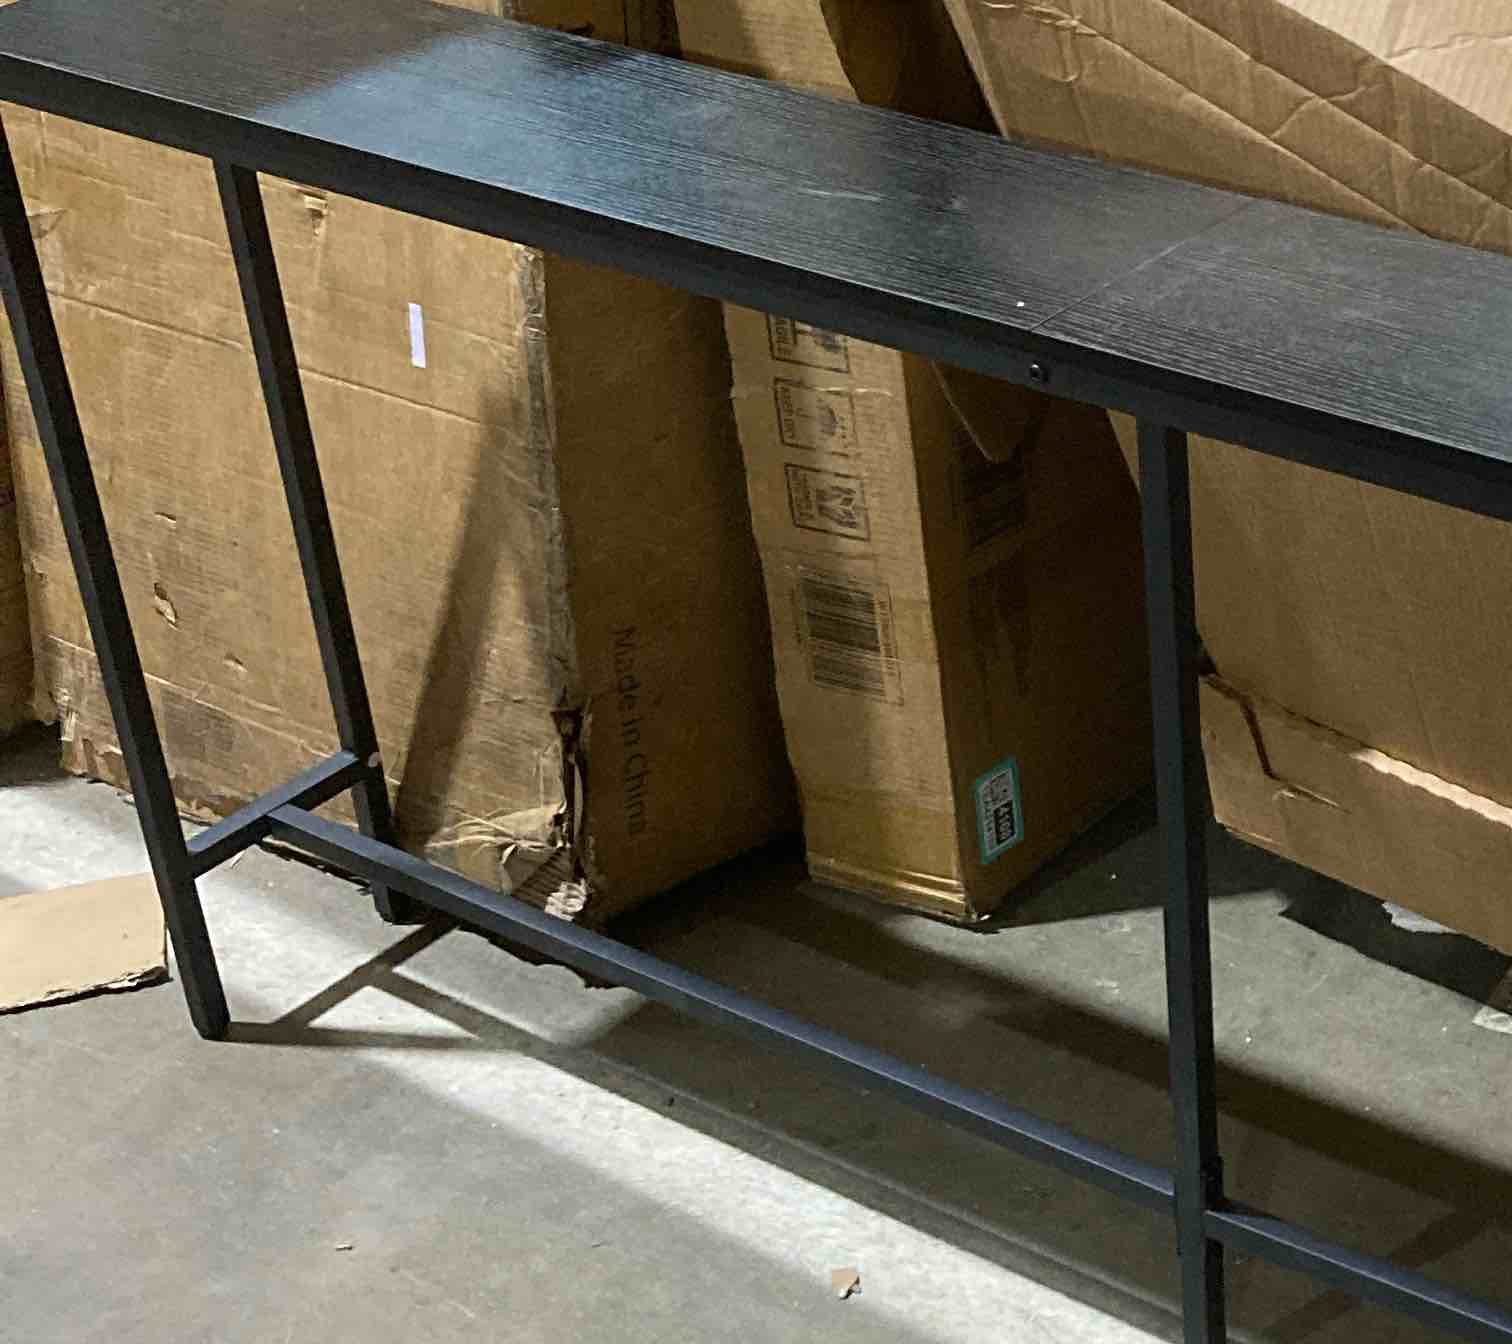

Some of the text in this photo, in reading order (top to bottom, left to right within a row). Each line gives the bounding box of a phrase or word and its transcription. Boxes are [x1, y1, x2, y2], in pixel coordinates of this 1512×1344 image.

[610, 625, 650, 836] Made in China
